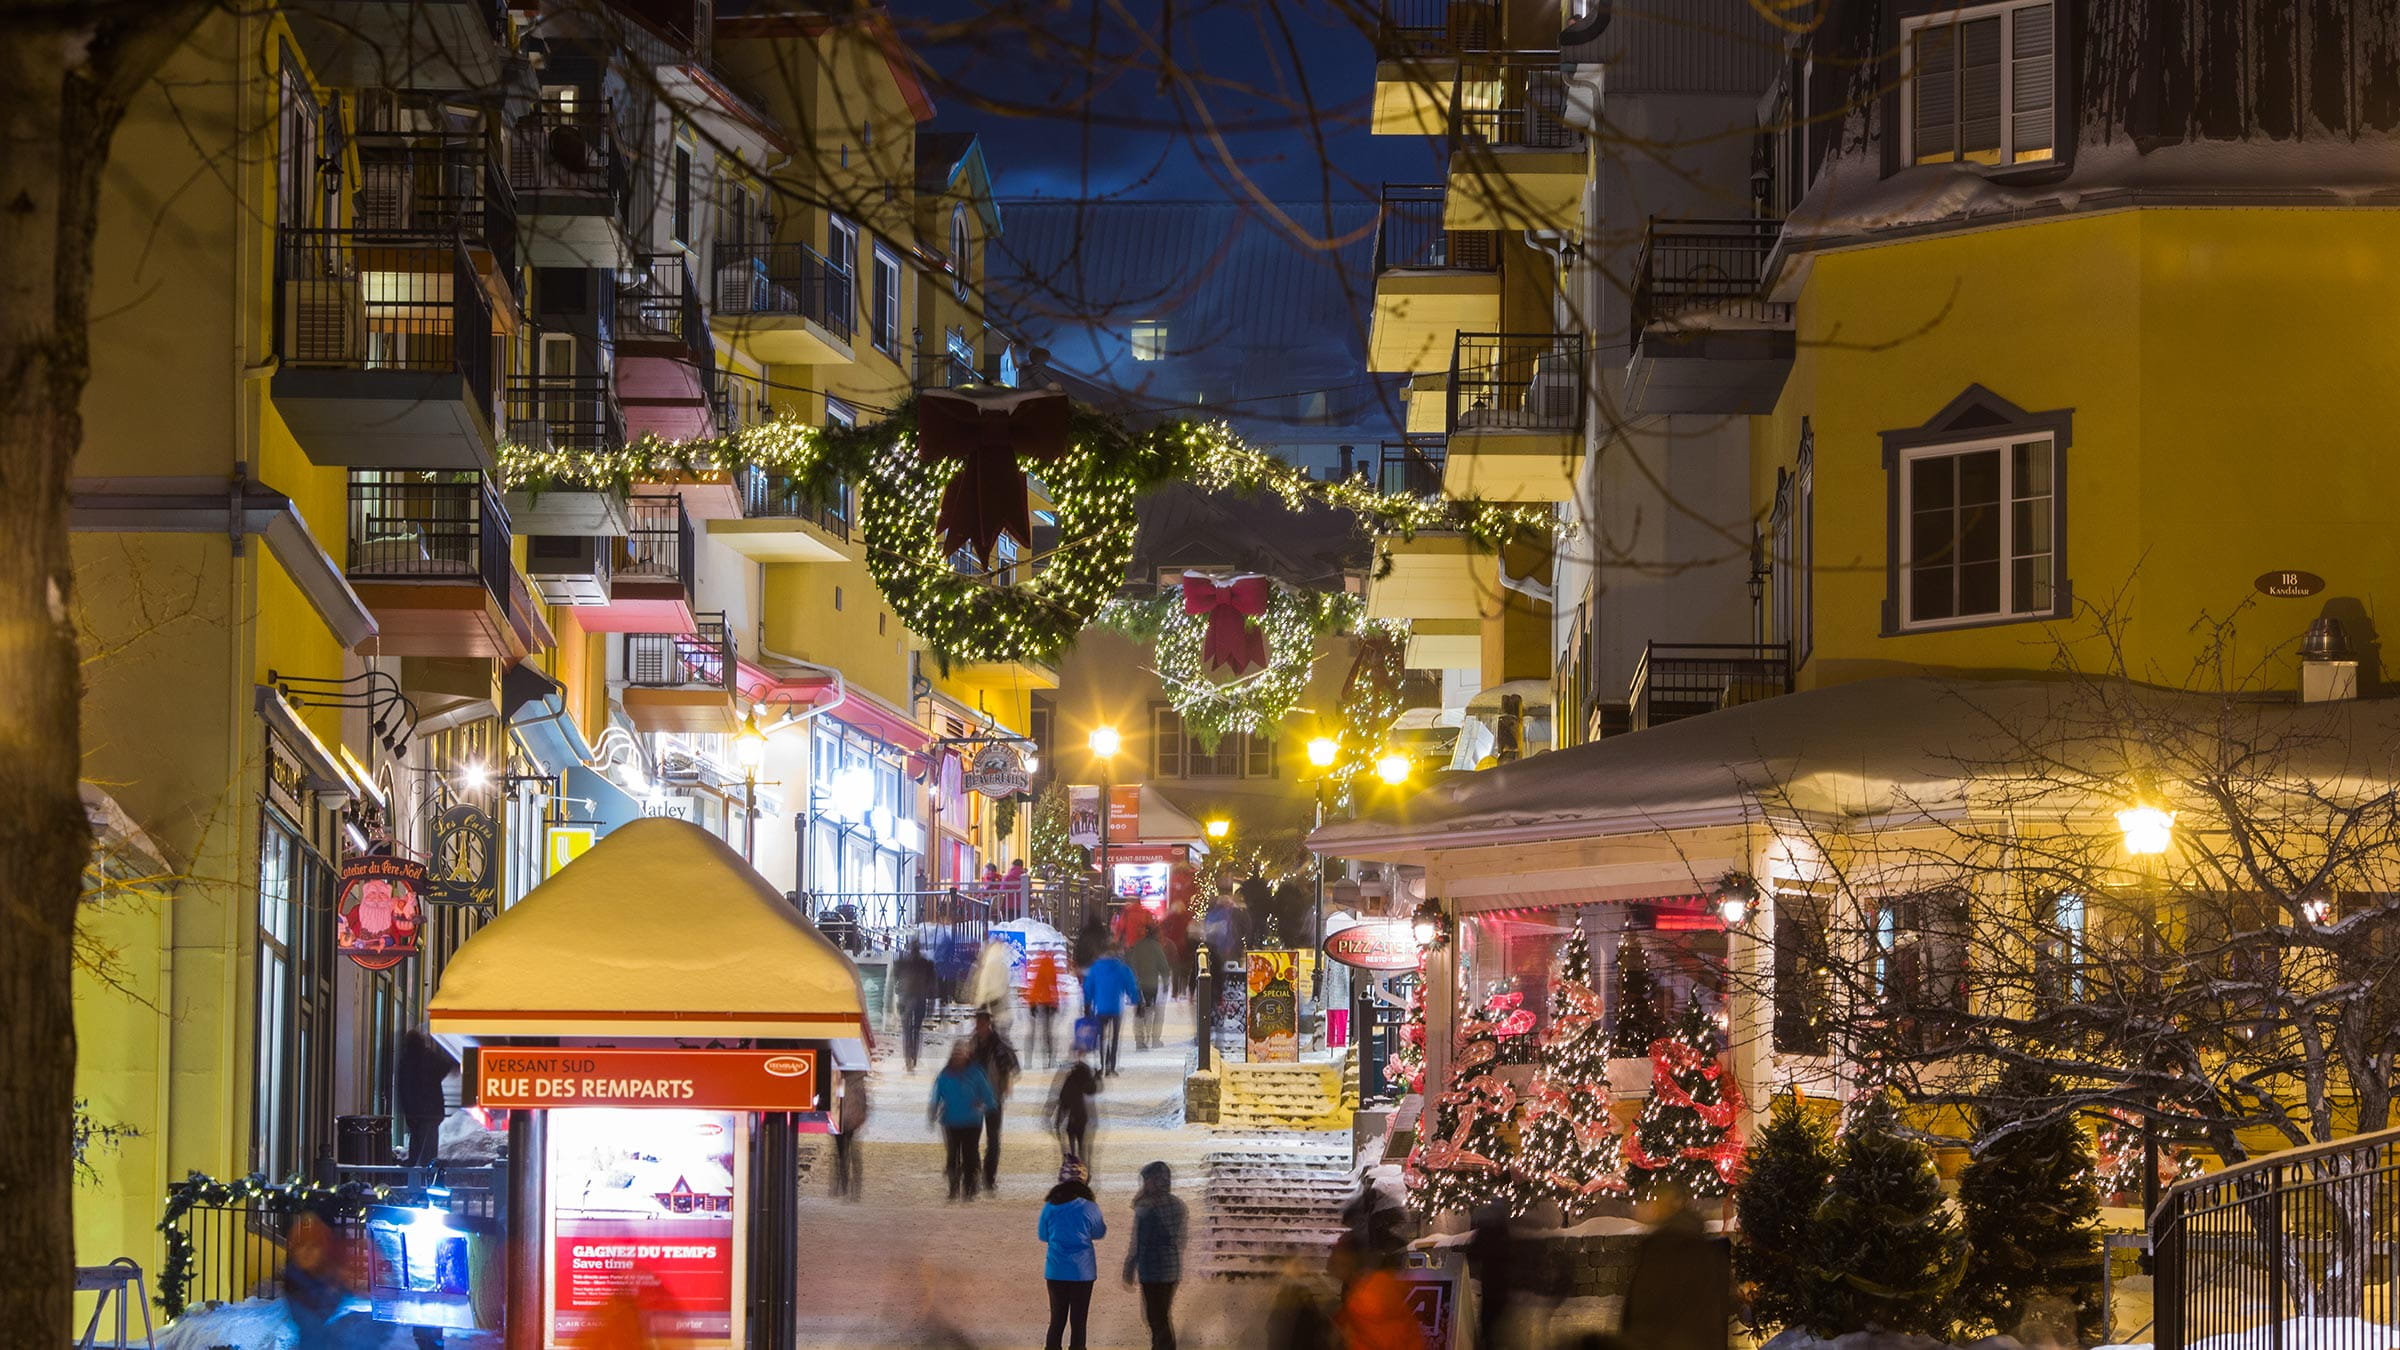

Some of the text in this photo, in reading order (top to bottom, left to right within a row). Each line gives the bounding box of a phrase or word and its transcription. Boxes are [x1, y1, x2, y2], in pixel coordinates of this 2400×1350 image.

[2282, 574, 2298, 585] 118
[1116, 854, 1164, 862] SAINT-BERNARD
[369, 861, 380, 874] du
[1337, 940, 1418, 954] PIZZATER
[487, 1059, 596, 1074] VERSANT SUD
[486, 1079, 694, 1099] RUE DES REMPARTS
[572, 1245, 716, 1258] GAGNEZ DU TEMPS
[572, 1258, 633, 1270] Save time
[676, 1320, 703, 1330] porter
